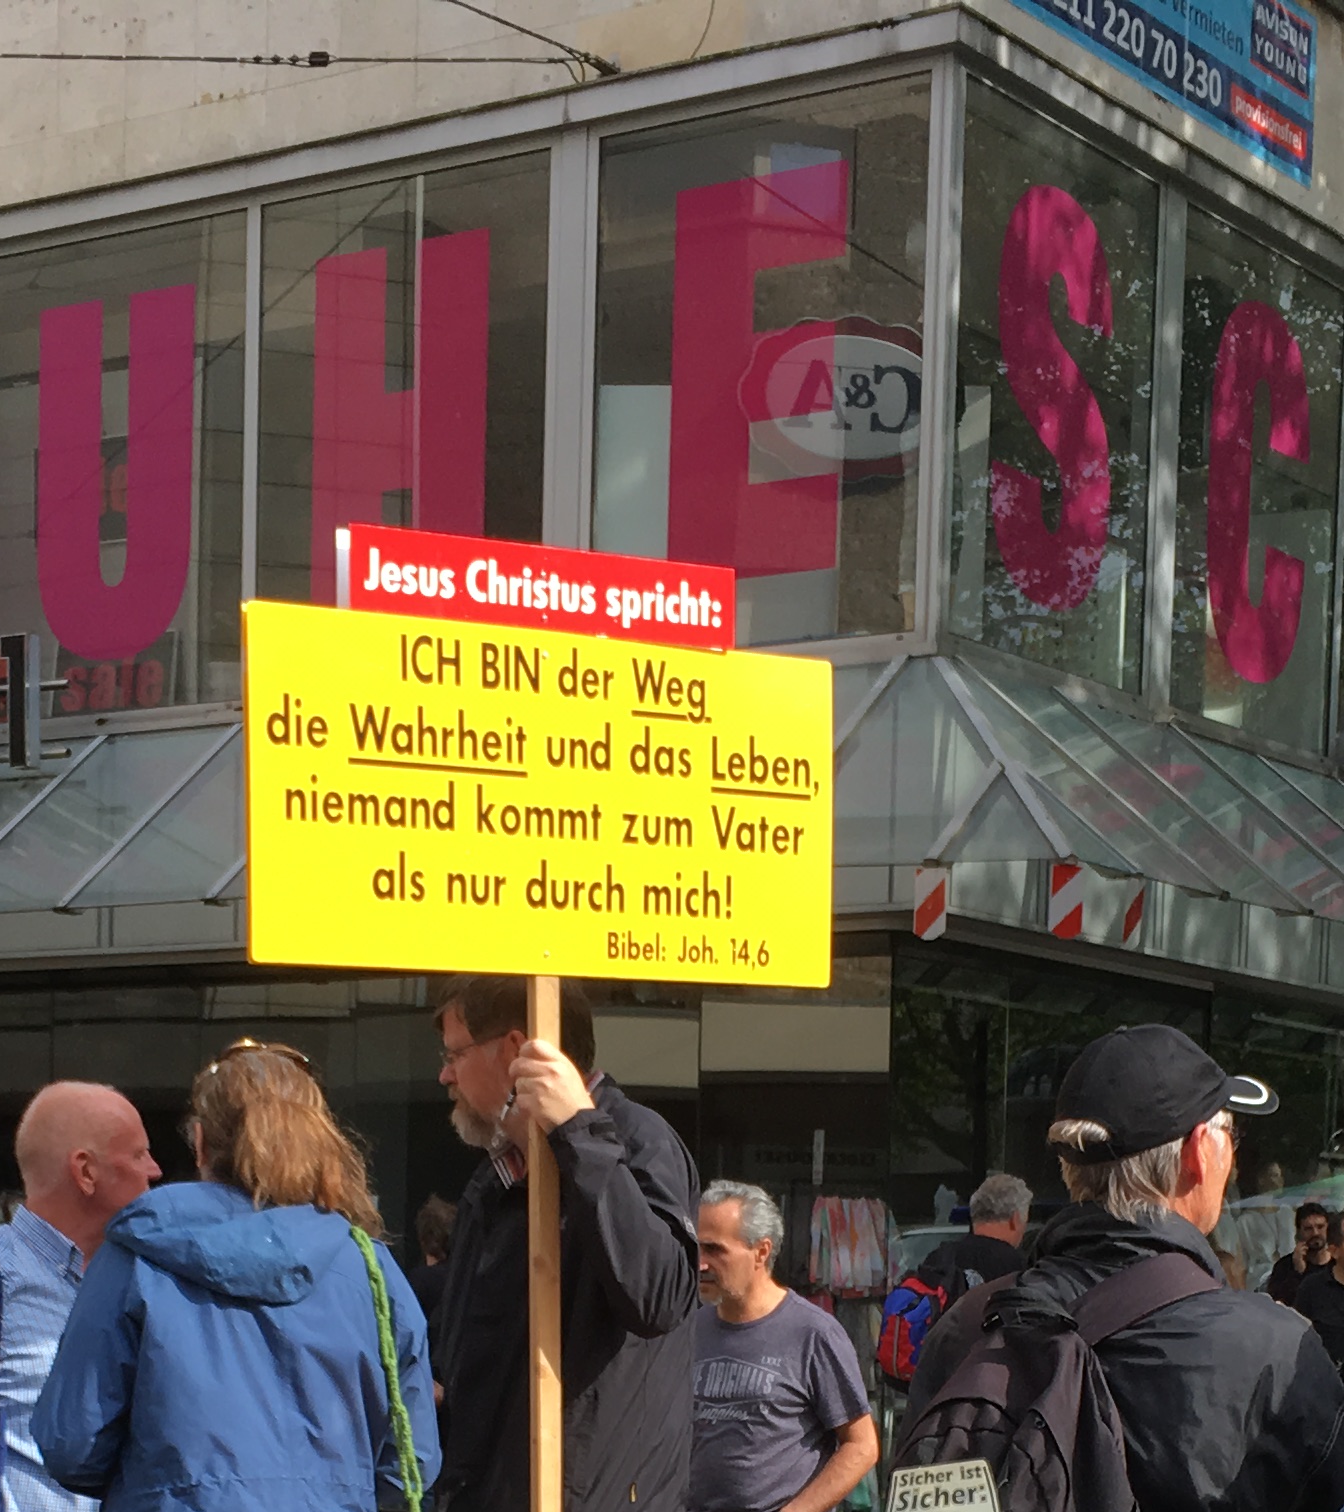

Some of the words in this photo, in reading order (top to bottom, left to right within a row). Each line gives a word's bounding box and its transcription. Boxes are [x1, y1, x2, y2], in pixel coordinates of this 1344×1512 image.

[1103, 0, 1145, 58] 220
[1151, 28, 1177, 79] 70
[1182, 51, 1223, 107] 230
[1255, 4, 1309, 55] AVISON
[1255, 33, 1307, 84] YOUNG
[1235, 95, 1303, 151] provisionsfrei
[364, 548, 455, 598] Jesus
[466, 558, 597, 615] Christus
[606, 580, 724, 628] spricht:
[400, 634, 461, 687] ICH
[481, 643, 540, 695] BIN
[558, 648, 615, 701] der
[632, 658, 708, 724] Weg
[266, 693, 329, 746] die
[349, 703, 528, 770] Wahrheit
[546, 723, 611, 772] und
[629, 726, 692, 778] das
[711, 735, 820, 799] Leben,
[285, 775, 456, 831] niemand
[477, 784, 602, 843] kommt
[622, 812, 693, 847] zum
[711, 806, 805, 856] Vater
[372, 850, 425, 902] als
[446, 869, 506, 907] nur
[526, 860, 625, 914] durch
[643, 875, 733, 919] mich!
[607, 932, 667, 963] Bibel:
[677, 935, 719, 965] Joh.
[730, 937, 771, 970] 14,6
[895, 1484, 988, 1512] Sicher:
[899, 1469, 953, 1487] Sicher
[960, 1465, 984, 1480] ist
